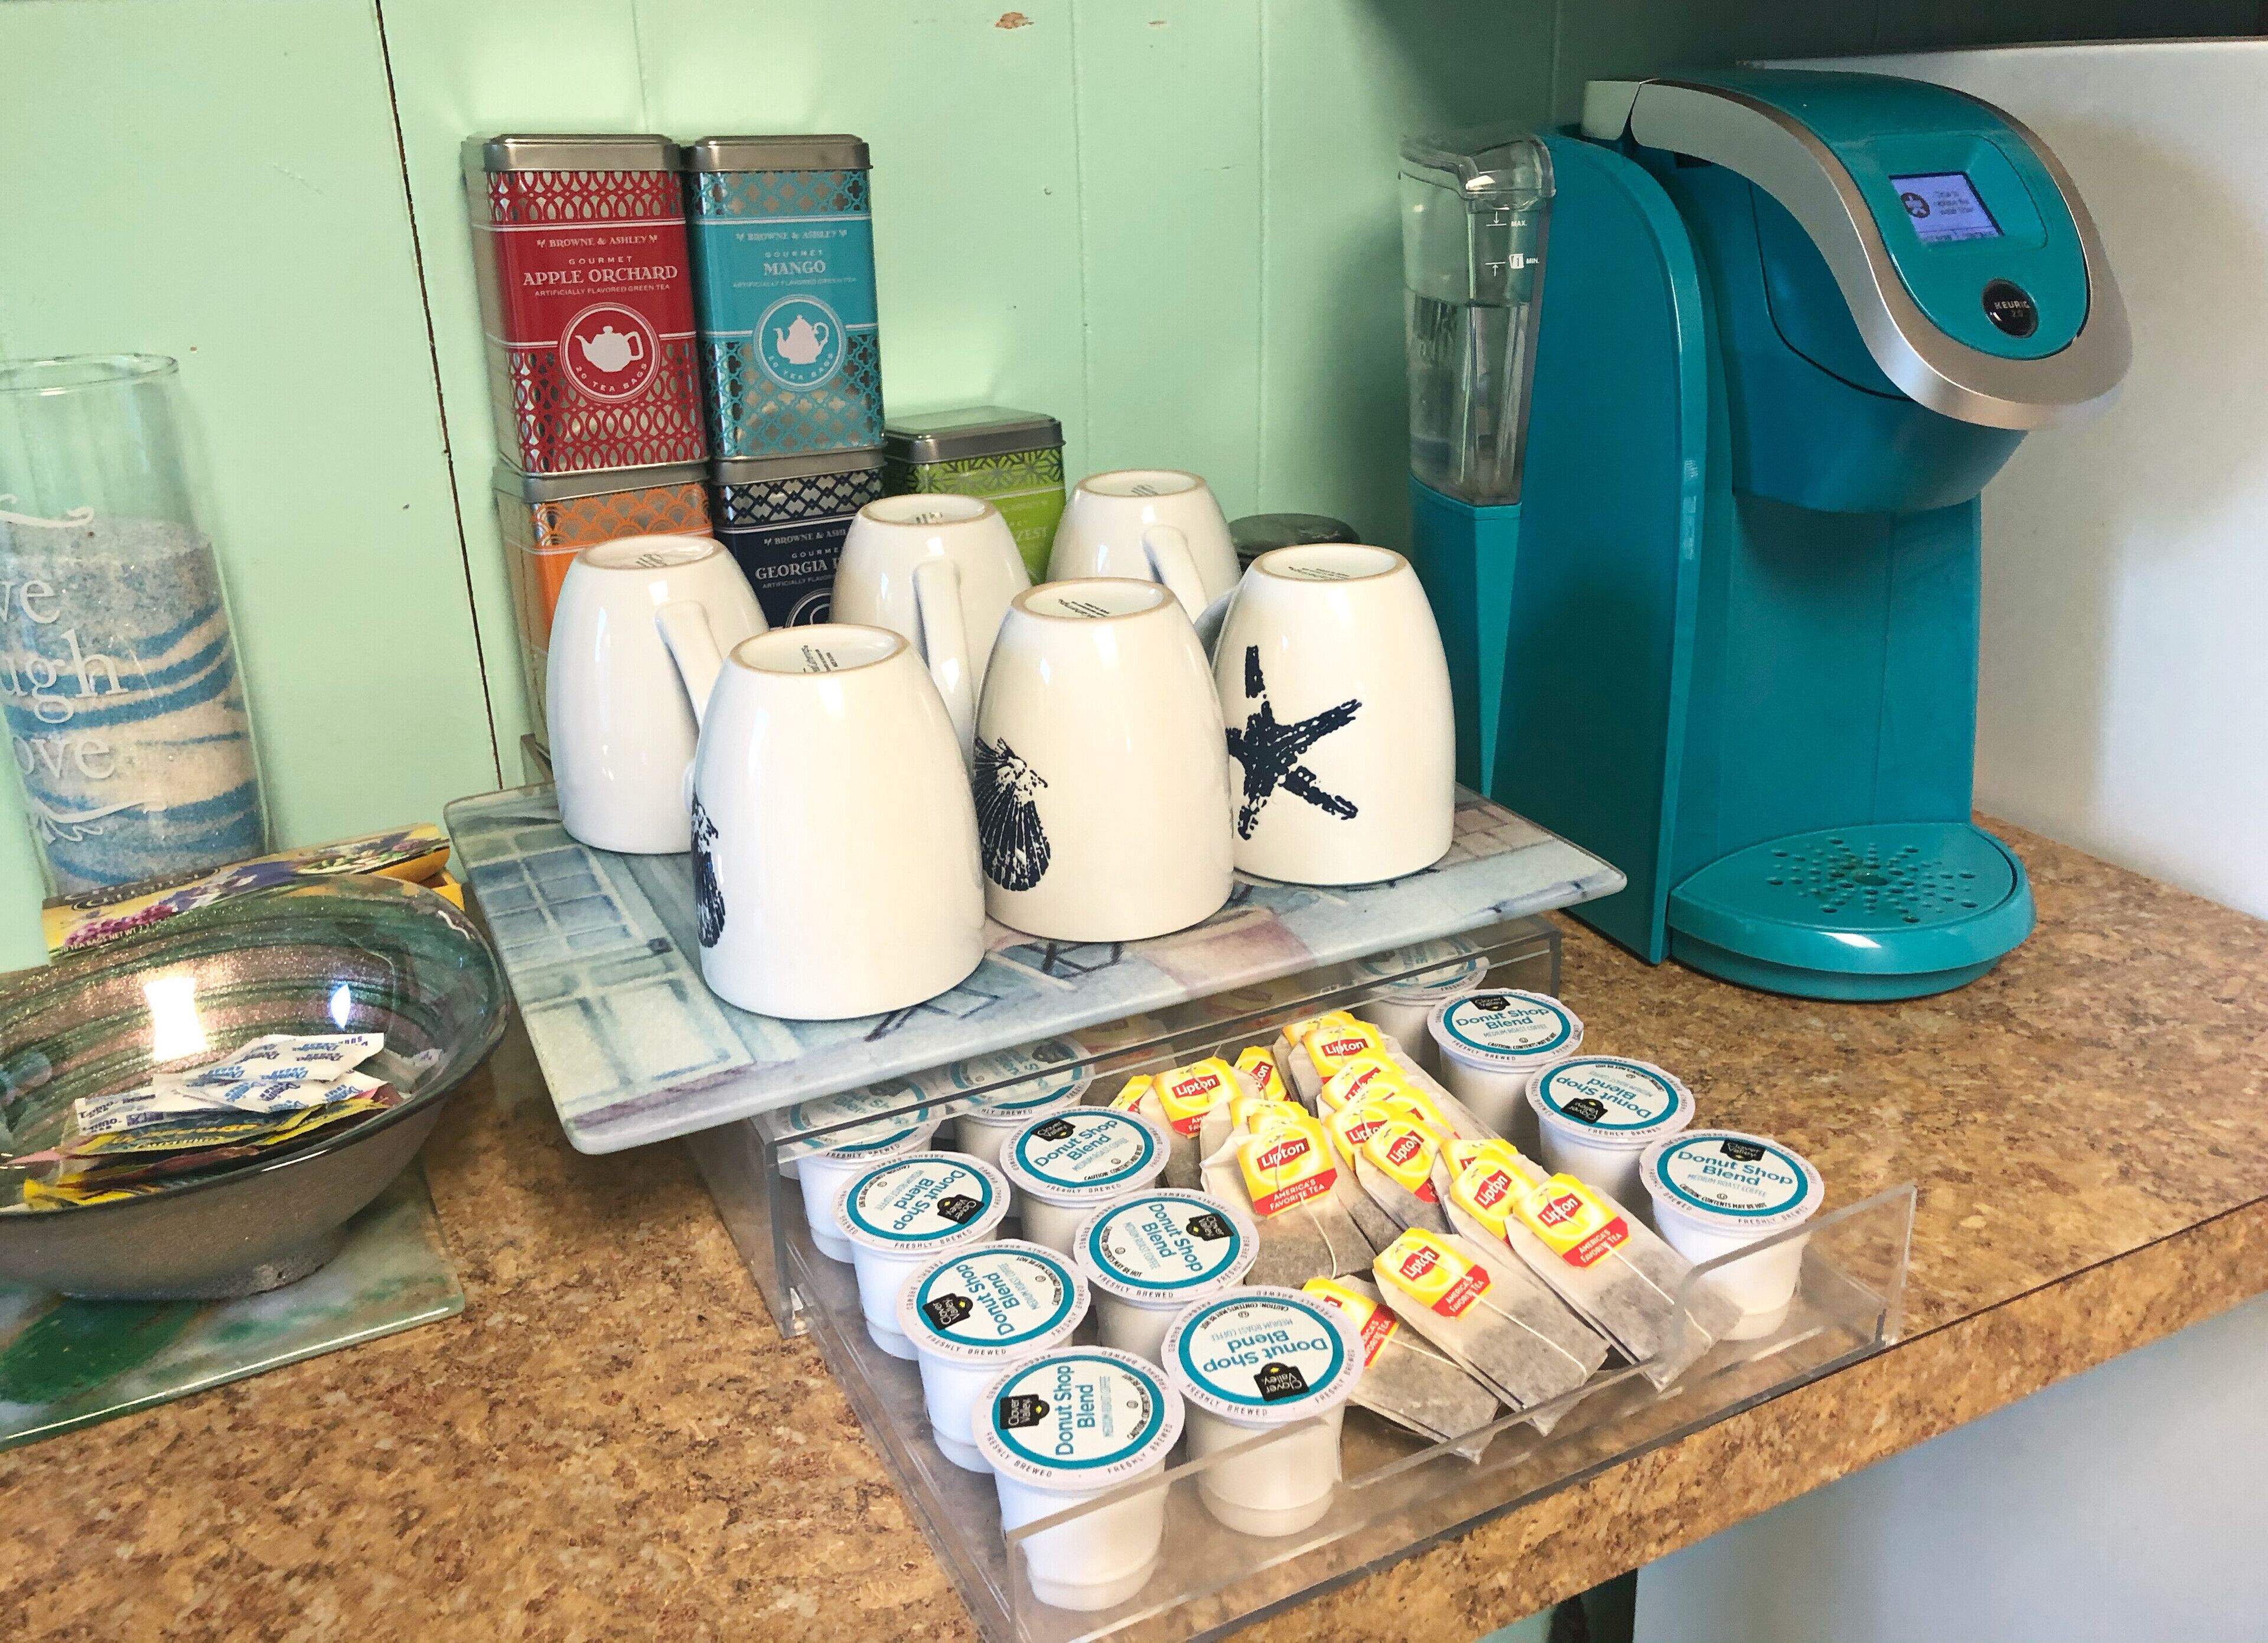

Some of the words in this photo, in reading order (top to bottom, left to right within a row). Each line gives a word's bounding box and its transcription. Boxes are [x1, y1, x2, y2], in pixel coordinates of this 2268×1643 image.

[550, 237, 594, 248] BROWNE
[610, 236, 646, 245] ASHLEY
[569, 256, 633, 265] GOURMET
[764, 260, 826, 275] MANGO
[523, 270, 584, 286] APPLE
[588, 266, 677, 283] ORCHARD
[535, 288, 585, 297] ARTIFICIALLY
[1995, 301, 2030, 309] KEURIG
[576, 366, 587, 379] 20
[593, 381, 615, 392] TEA
[623, 363, 647, 389] BAGS
[774, 533, 813, 545] BROWNE
[755, 560, 827, 580] GEORGIA
[763, 578, 805, 588] ARTIFICIALLY
[1456, 1013, 1506, 1026] Donut
[1507, 1007, 1549, 1017] Shop
[1486, 1017, 1533, 1029] Blend
[1325, 1041, 1364, 1055] Lipton
[1177, 1077, 1216, 1095] Lipton
[1556, 1077, 1598, 1096] Shop
[1586, 1078, 1637, 1100] Blend
[1600, 1092, 1652, 1118] Donut
[1034, 1139, 1082, 1167] Donut
[1078, 1120, 1118, 1140] Shop
[1067, 1134, 1111, 1160] Blend
[1262, 1142, 1305, 1167] Lipton
[1390, 1135, 1420, 1162] Lipton
[1678, 1151, 1738, 1170] Donut
[1742, 1165, 1793, 1185] Shop
[1703, 1166, 1760, 1186] Blend
[894, 1177, 936, 1211] Blend
[927, 1170, 966, 1200] Donut
[1270, 1192, 1307, 1211] FAVORITE
[1309, 1184, 1325, 1195] TEA
[1273, 1179, 1316, 1201] AMERICA'S
[1478, 1174, 1508, 1205] Lipton
[893, 1199, 931, 1231] Shop
[1542, 1198, 1578, 1224] Lipton
[940, 1229, 972, 1245] BREWED
[1142, 1222, 1177, 1258] Blend
[1148, 1203, 1182, 1237] Donut
[1174, 1238, 1203, 1271] Shop
[1578, 1229, 1611, 1254] AMERICA'S
[1580, 1241, 1610, 1264] FAVORITE
[1609, 1232, 1622, 1244] TEA
[1403, 1250, 1436, 1277] Lipton
[956, 1264, 986, 1294] Shop
[982, 1271, 1021, 1309] Blend
[1097, 1274, 1130, 1293] FRESHLY
[1136, 1290, 1174, 1298] BREWED
[1445, 1275, 1474, 1304] AMERICA'S
[1471, 1280, 1484, 1291] TEA
[977, 1291, 1015, 1336] Donut
[1377, 1320, 1391, 1332] TEA
[926, 1335, 961, 1352] FRESHLY
[1227, 1330, 1289, 1353] Blend
[1264, 1338, 1328, 1359] Donut
[1203, 1351, 1259, 1373] Shop
[1053, 1365, 1074, 1400] Shop
[1263, 1372, 1296, 1385] Valley
[1266, 1380, 1302, 1394] Clover
[1186, 1383, 1220, 1407] FRESHLY
[1227, 1404, 1267, 1417] BREWED
[1315, 1379, 1345, 1404] FRESHLY
[1008, 1398, 1019, 1426] Clover
[1021, 1397, 1032, 1424] Valley
[1075, 1384, 1095, 1429] Blend
[1055, 1404, 1074, 1456] Donut
[986, 1431, 1010, 1460] FRESHLY
[1014, 1460, 1052, 1478] BREWED
[1107, 1453, 1146, 1475] FRESHLY
[1150, 1423, 1173, 1452] BREWED
